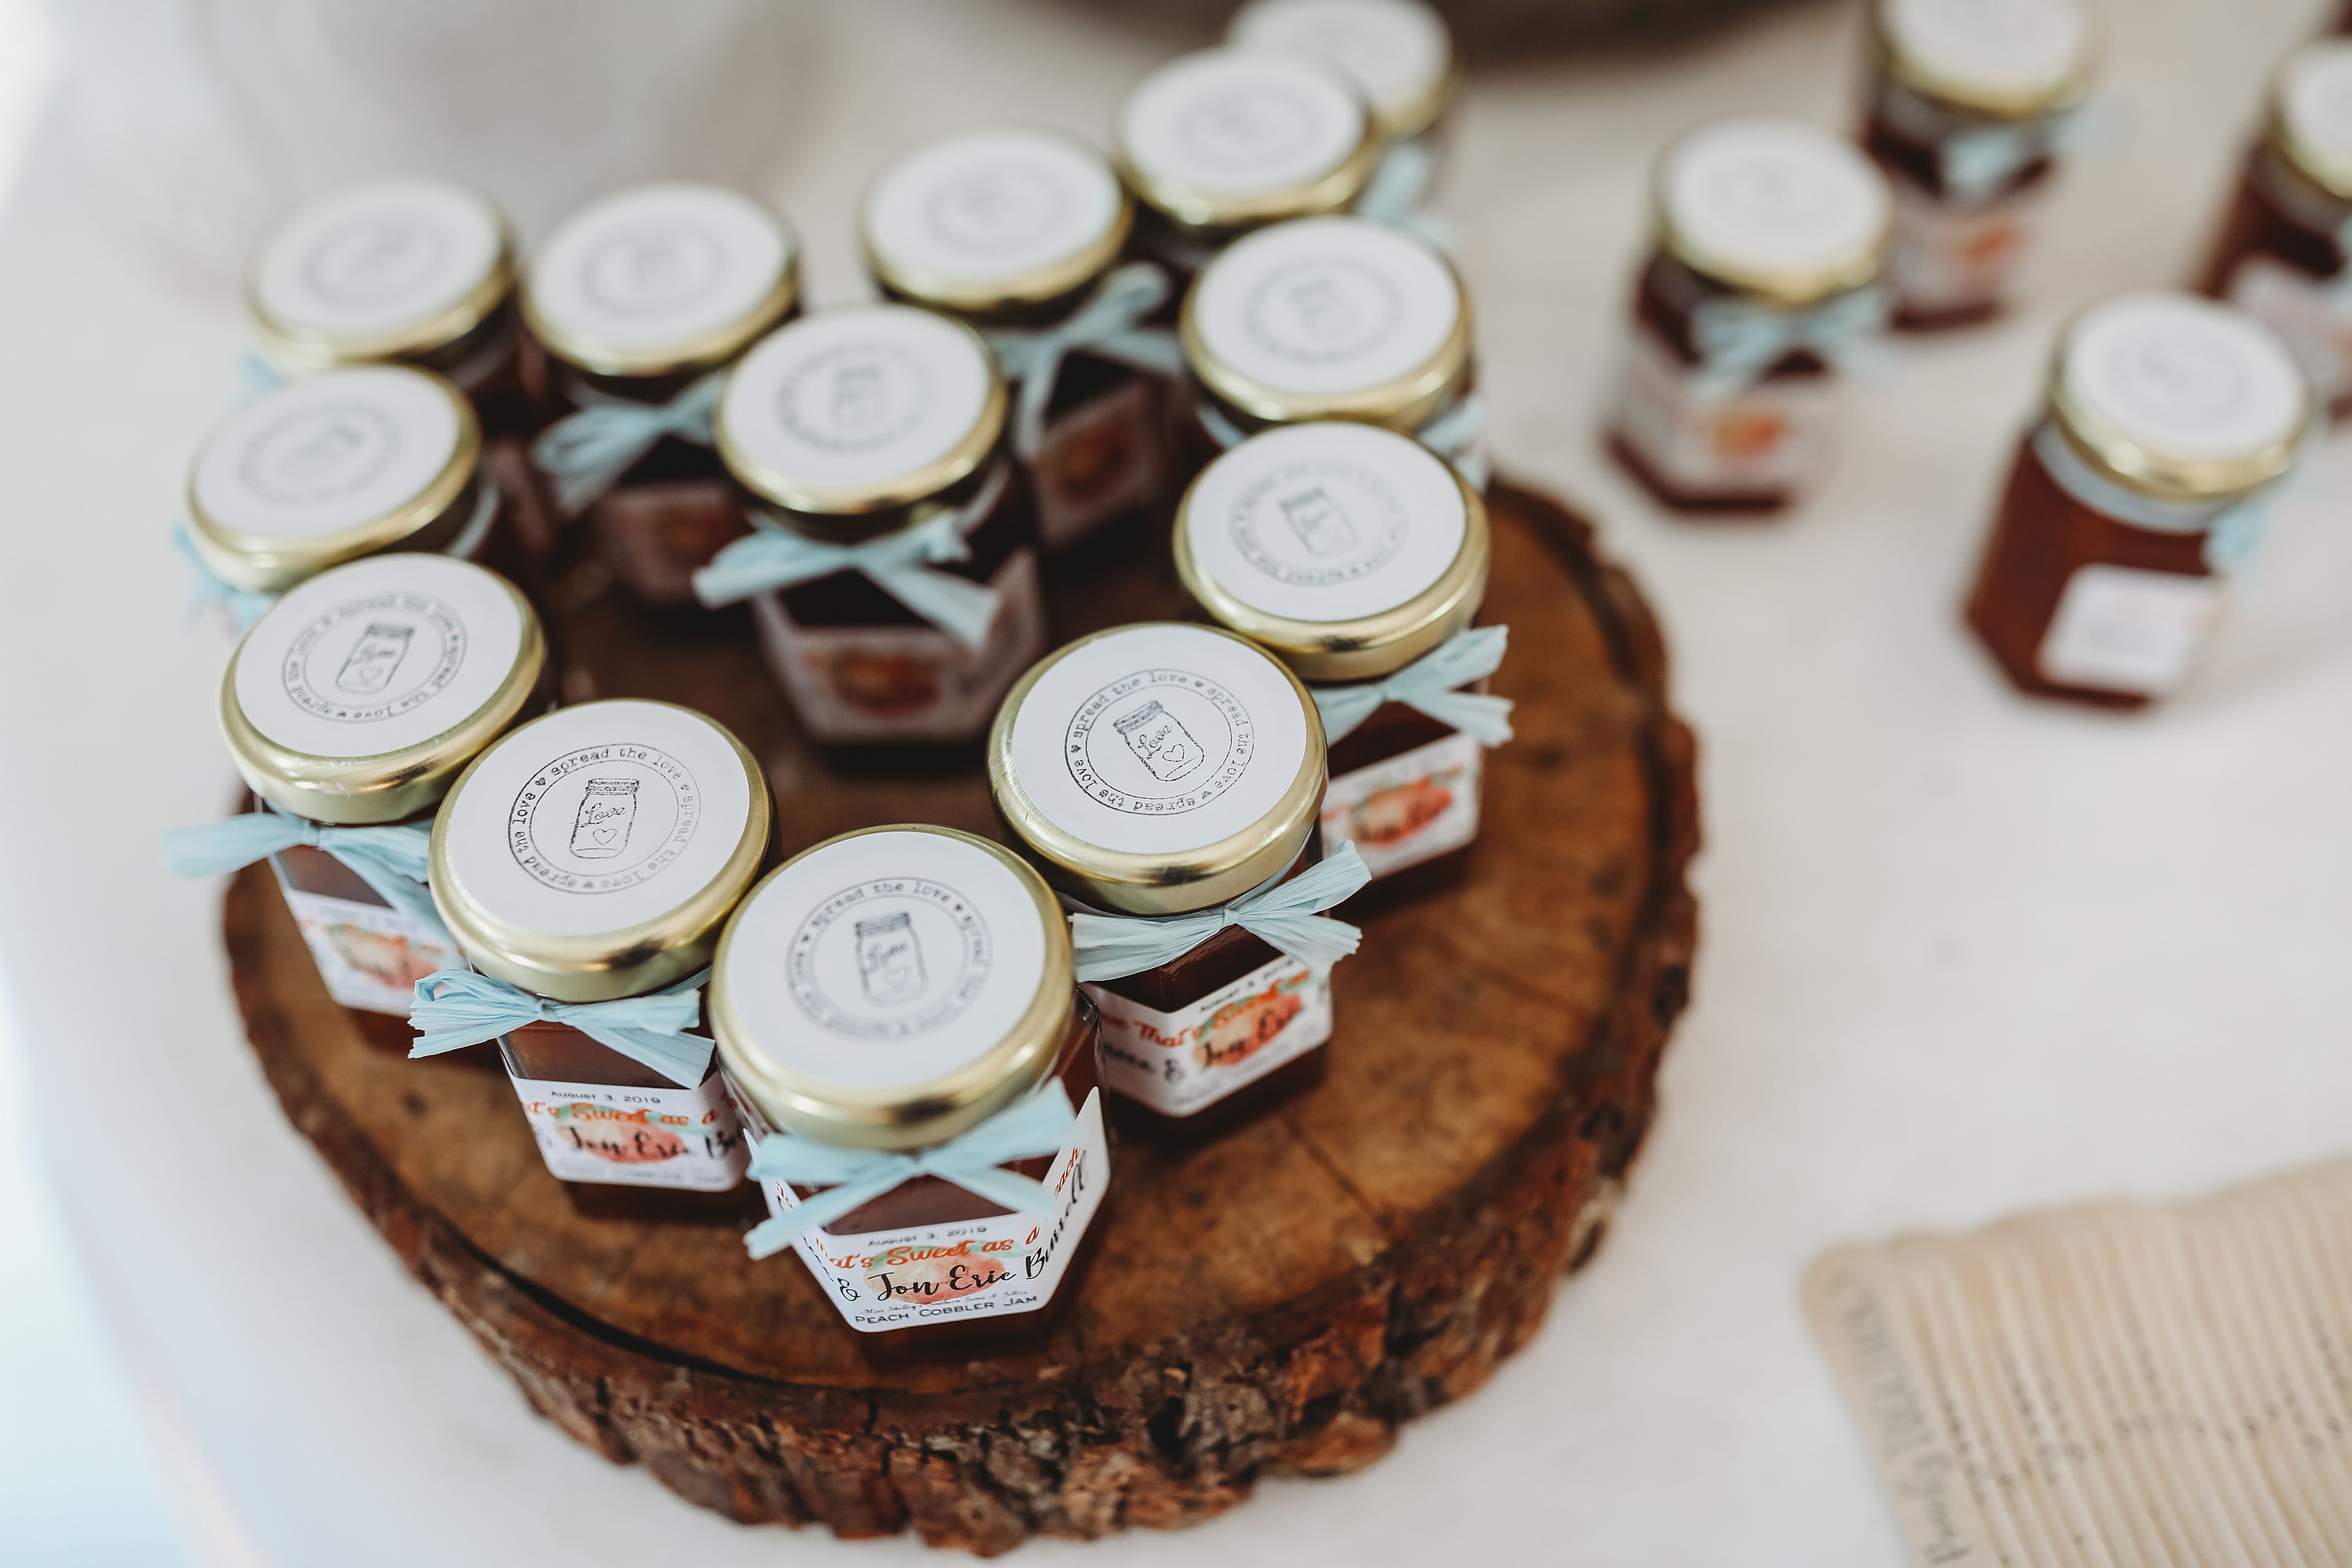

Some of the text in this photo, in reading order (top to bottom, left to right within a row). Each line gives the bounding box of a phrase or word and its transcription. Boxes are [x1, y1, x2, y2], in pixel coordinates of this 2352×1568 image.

[1073, 672, 1187, 739] spread the love
[1207, 688, 1252, 789] spread the love
[551, 748, 681, 779] spread the love
[1073, 759, 1196, 811] spread the love
[512, 792, 577, 888] spread the love
[601, 795, 695, 888] spread the love
[812, 882, 949, 925] spread the love
[551, 1091, 596, 1100] AUGUST
[570, 1102, 652, 1124] Sweet
[660, 1114, 690, 1126] as
[887, 1240, 977, 1266] Sweet
[982, 1239, 1014, 1253] as
[1025, 1226, 1040, 1245] a
[1054, 1147, 1079, 1200] each
[869, 1235, 918, 1247] AUGUST
[947, 1226, 986, 1236] 2019
[837, 1277, 862, 1302] &
[867, 1272, 940, 1301] Jon
[949, 1265, 1017, 1291] Eric
[855, 1295, 1038, 1324] PEACH COBBLER JAM
